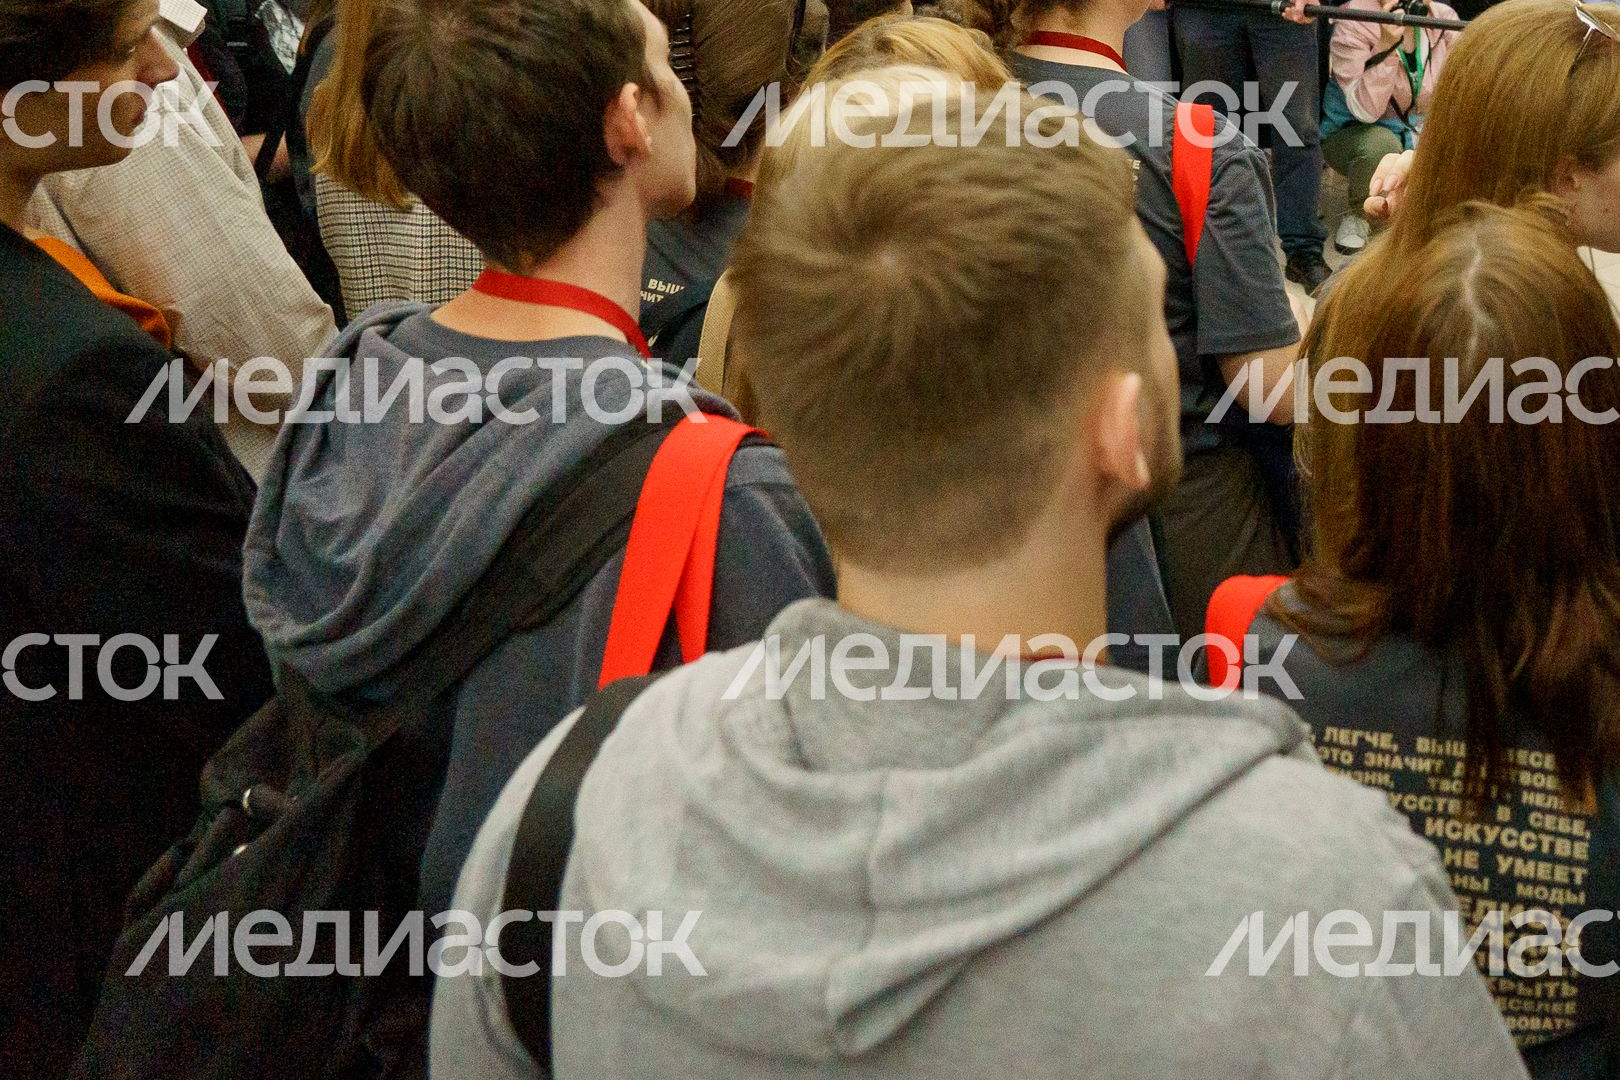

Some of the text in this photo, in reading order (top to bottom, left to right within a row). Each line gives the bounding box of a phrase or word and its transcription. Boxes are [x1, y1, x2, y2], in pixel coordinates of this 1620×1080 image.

[1323, 726, 1398, 753] ЛЕГЧЕ,
[1364, 752, 1444, 774] ЗНАЧИТ
[1424, 816, 1590, 860] ИСКУССТВЕ
[1527, 810, 1591, 840] СЕБЕ,
[1496, 853, 1588, 886] УМЕЕТ
[1515, 883, 1586, 906] МОДЫ
